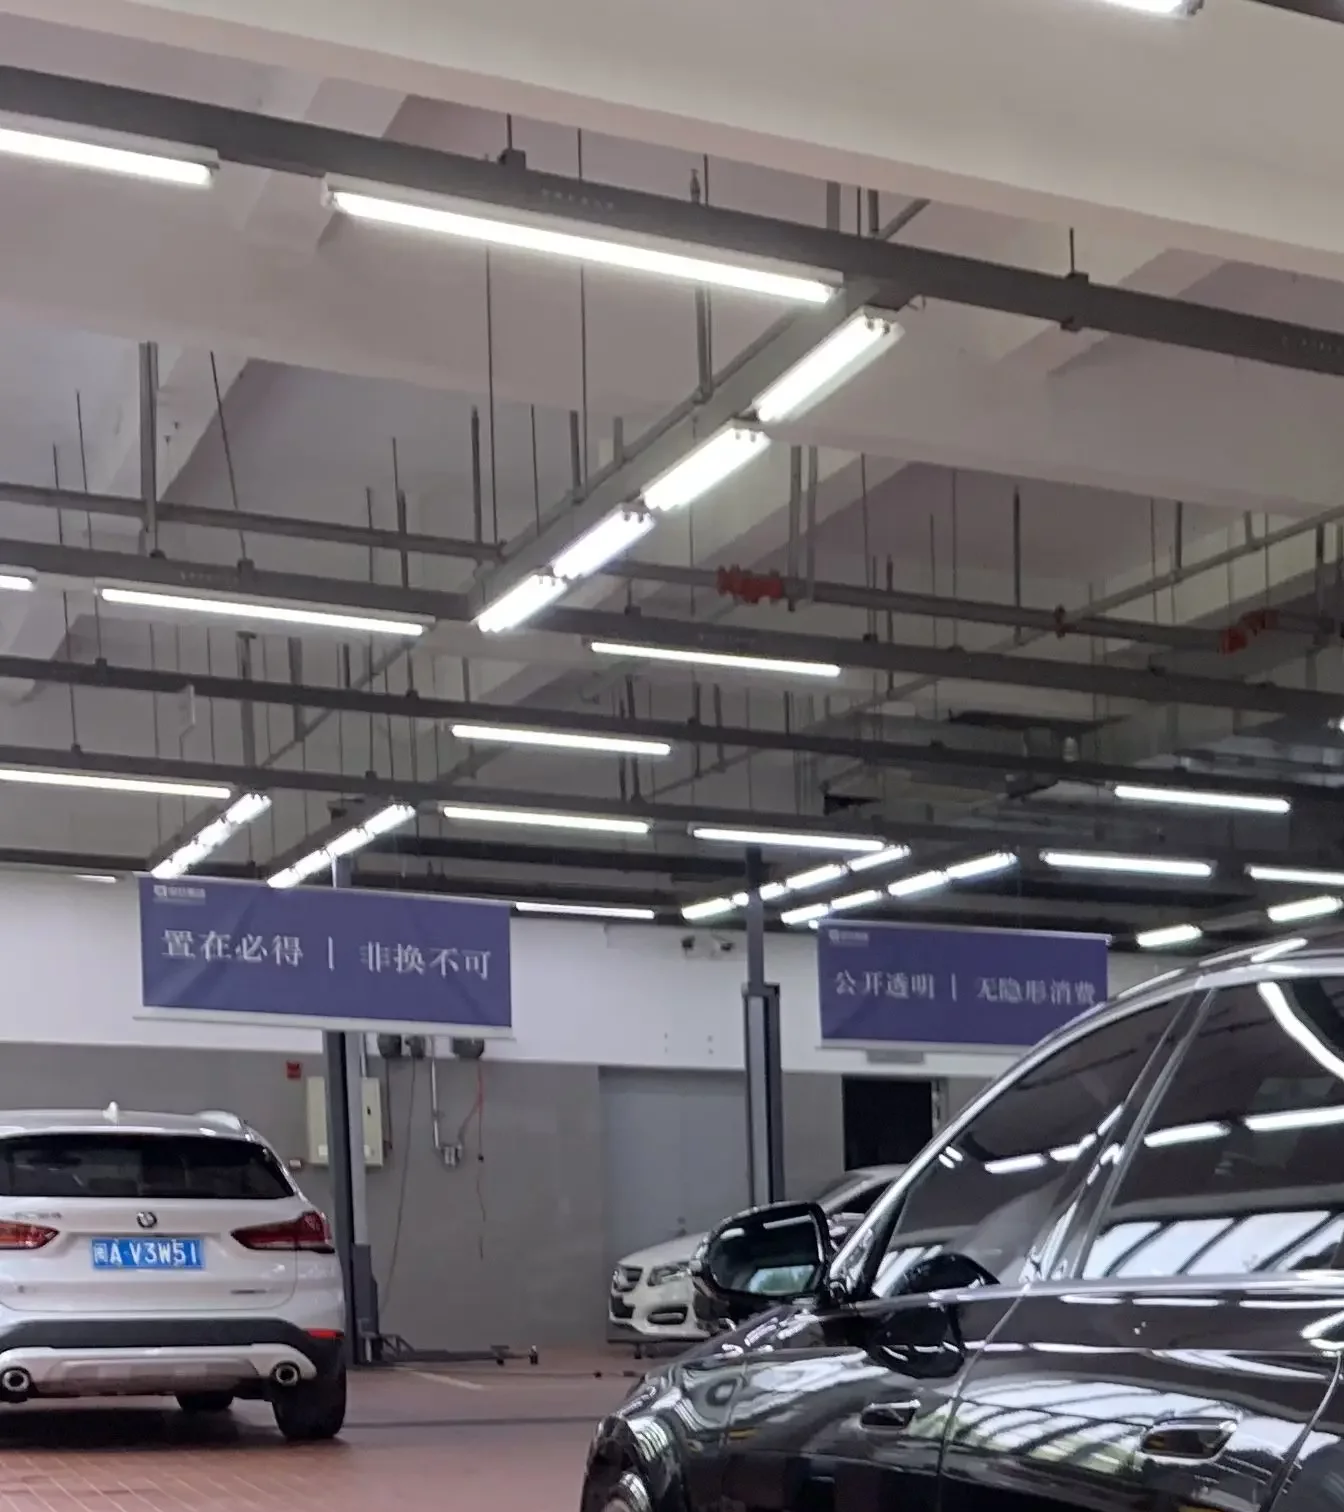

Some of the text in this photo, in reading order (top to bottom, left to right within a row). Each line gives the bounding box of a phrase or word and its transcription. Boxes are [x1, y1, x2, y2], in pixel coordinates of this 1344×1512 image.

[359, 940, 492, 981] 非换不可
[834, 969, 1096, 1006] 公开透明 无隐形消费
